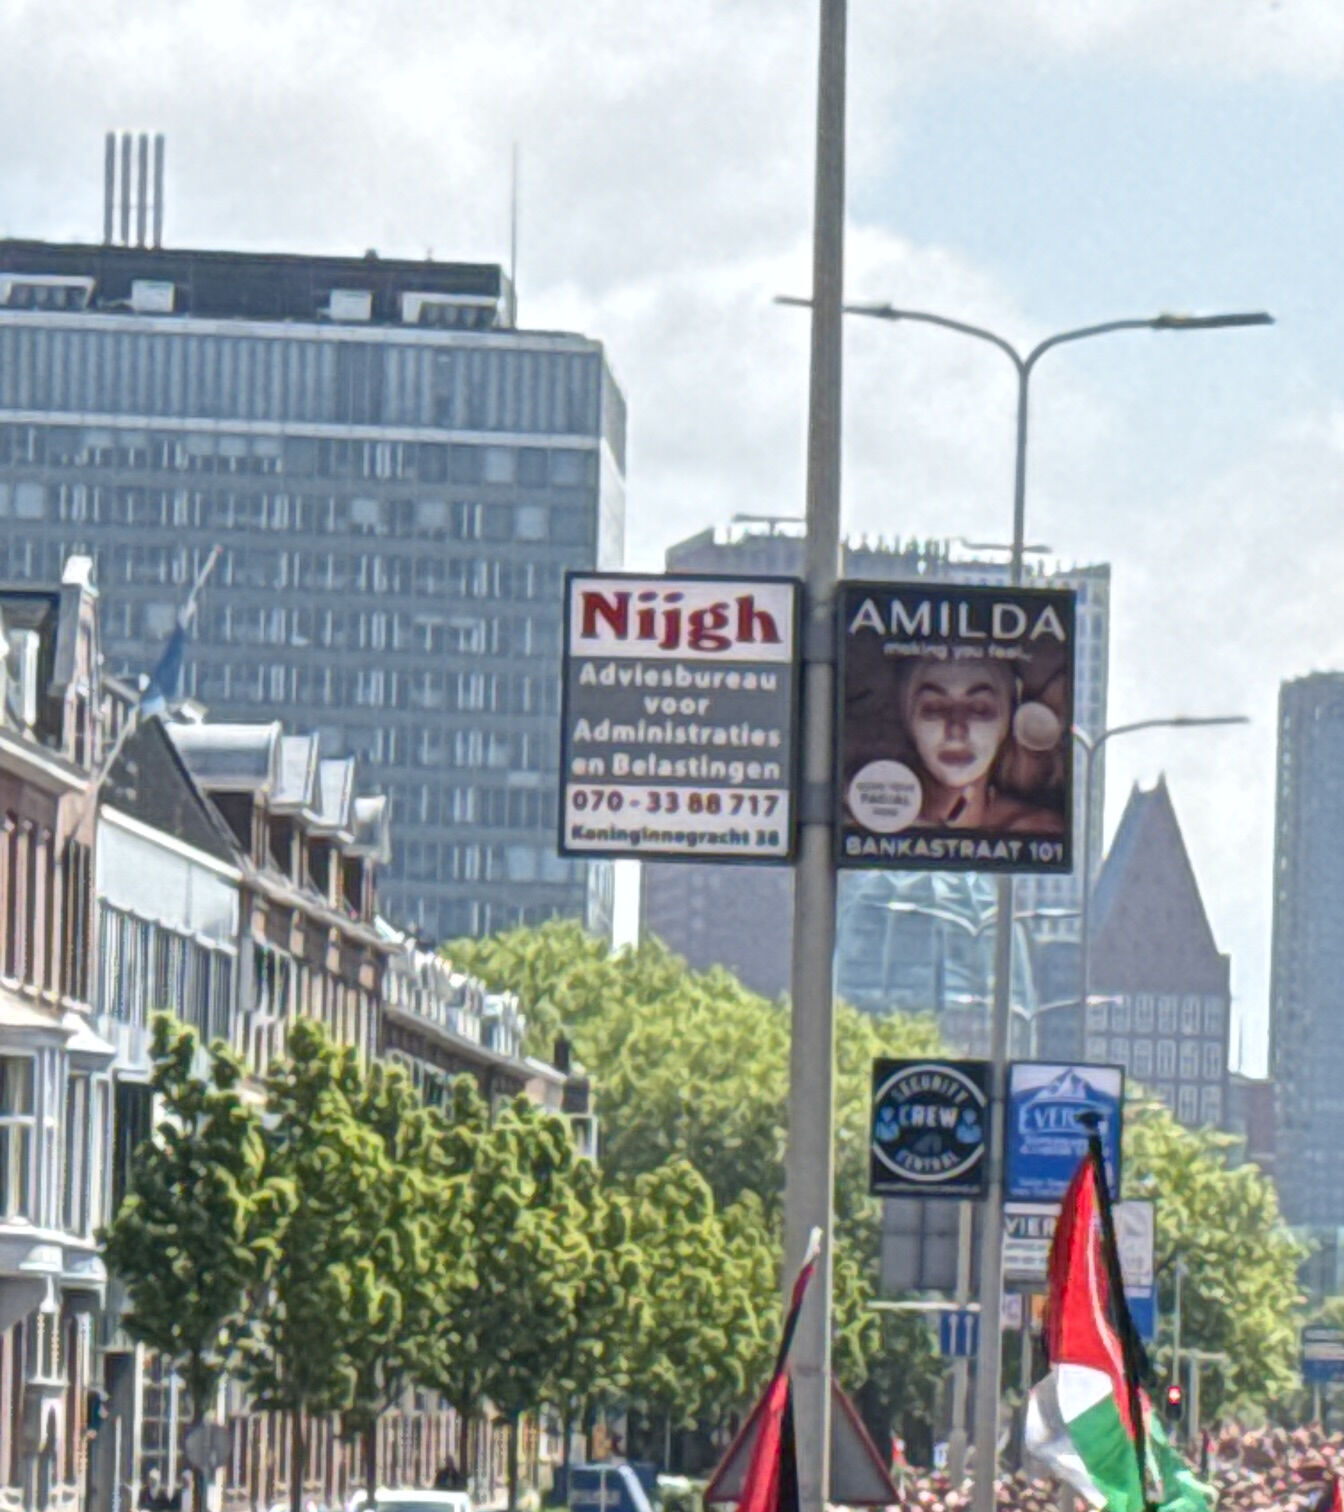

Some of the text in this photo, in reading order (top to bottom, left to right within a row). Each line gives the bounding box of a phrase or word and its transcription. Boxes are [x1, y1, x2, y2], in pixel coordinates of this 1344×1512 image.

[579, 591, 782, 652] Nijgh
[849, 598, 1066, 642] AMILDA
[579, 662, 778, 692] Adviesbureau
[644, 697, 710, 715] voor
[573, 718, 781, 747] Administraties
[571, 753, 780, 784] en Belastingen
[572, 790, 623, 812] 070
[646, 791, 680, 814] 33
[687, 792, 721, 815] 88
[729, 794, 780, 817] 717
[571, 825, 750, 847] Koninginnegracht
[845, 836, 1064, 863] BANKASTRAAT 101
[898, 1104, 959, 1128] CREW
